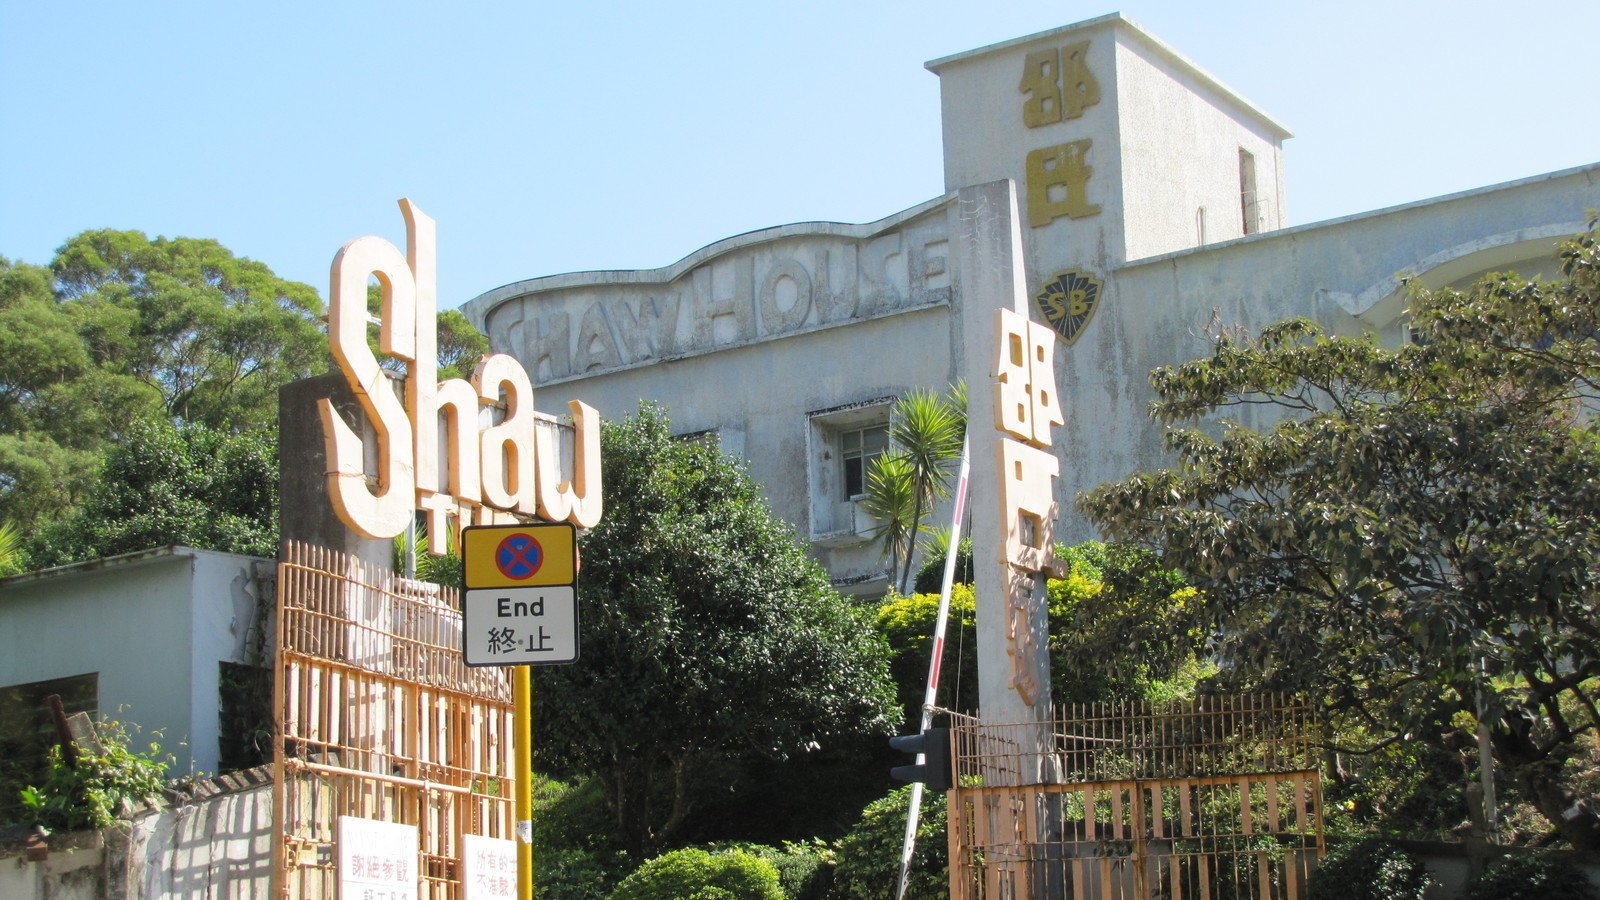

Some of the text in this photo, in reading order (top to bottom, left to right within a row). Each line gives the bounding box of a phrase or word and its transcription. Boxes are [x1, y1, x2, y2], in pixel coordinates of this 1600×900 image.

[485, 226, 952, 386] SHAW HOUSE
[316, 197, 603, 539] Shaw
[488, 626, 554, 654] 終止
[497, 597, 544, 617] End
